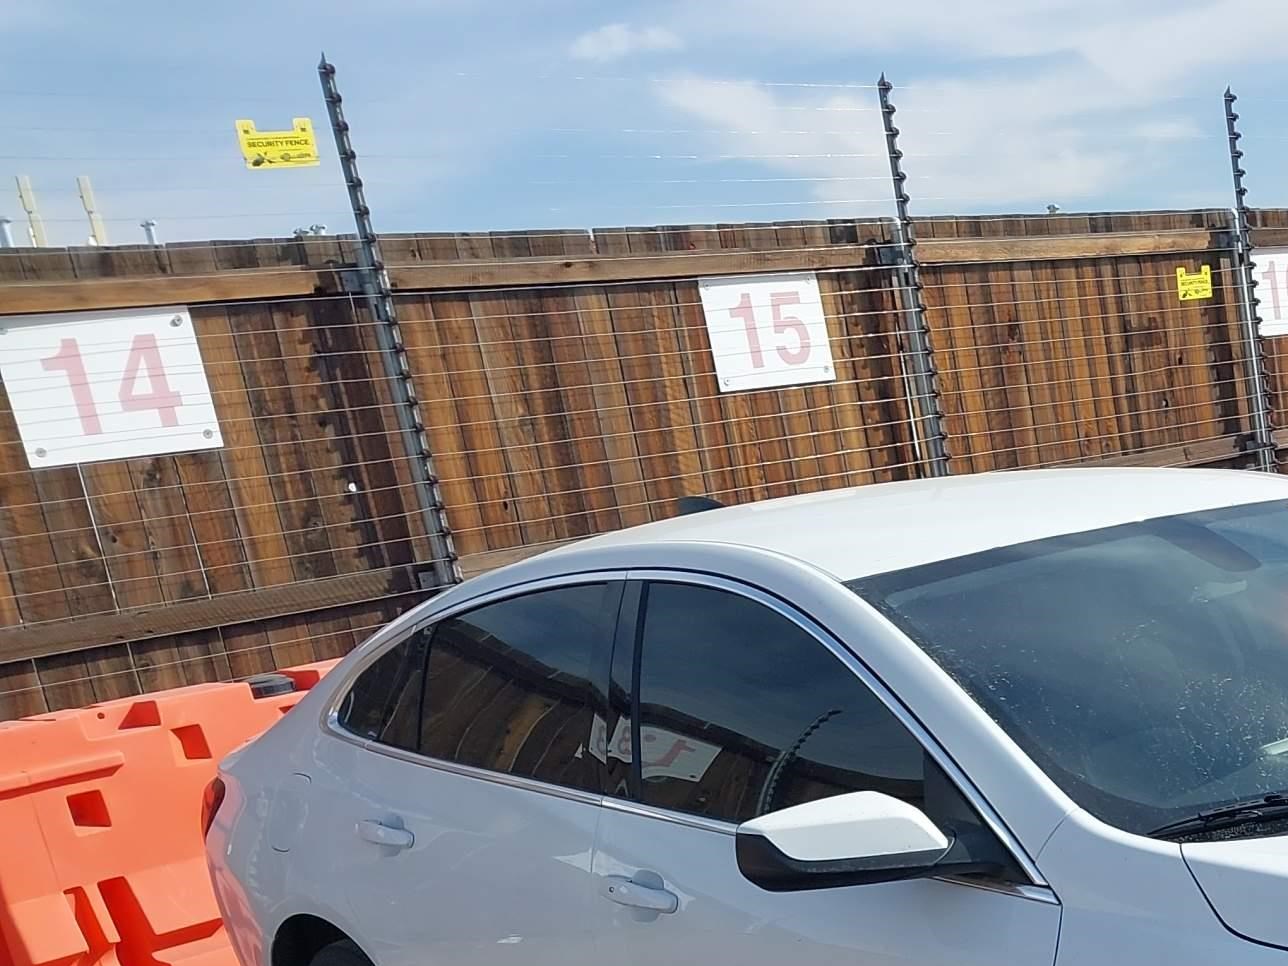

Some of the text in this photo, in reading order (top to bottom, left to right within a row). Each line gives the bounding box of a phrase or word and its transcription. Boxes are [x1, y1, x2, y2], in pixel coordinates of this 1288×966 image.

[247, 140, 283, 148] SECURITY
[728, 291, 811, 369] 15
[40, 333, 183, 436] 14
